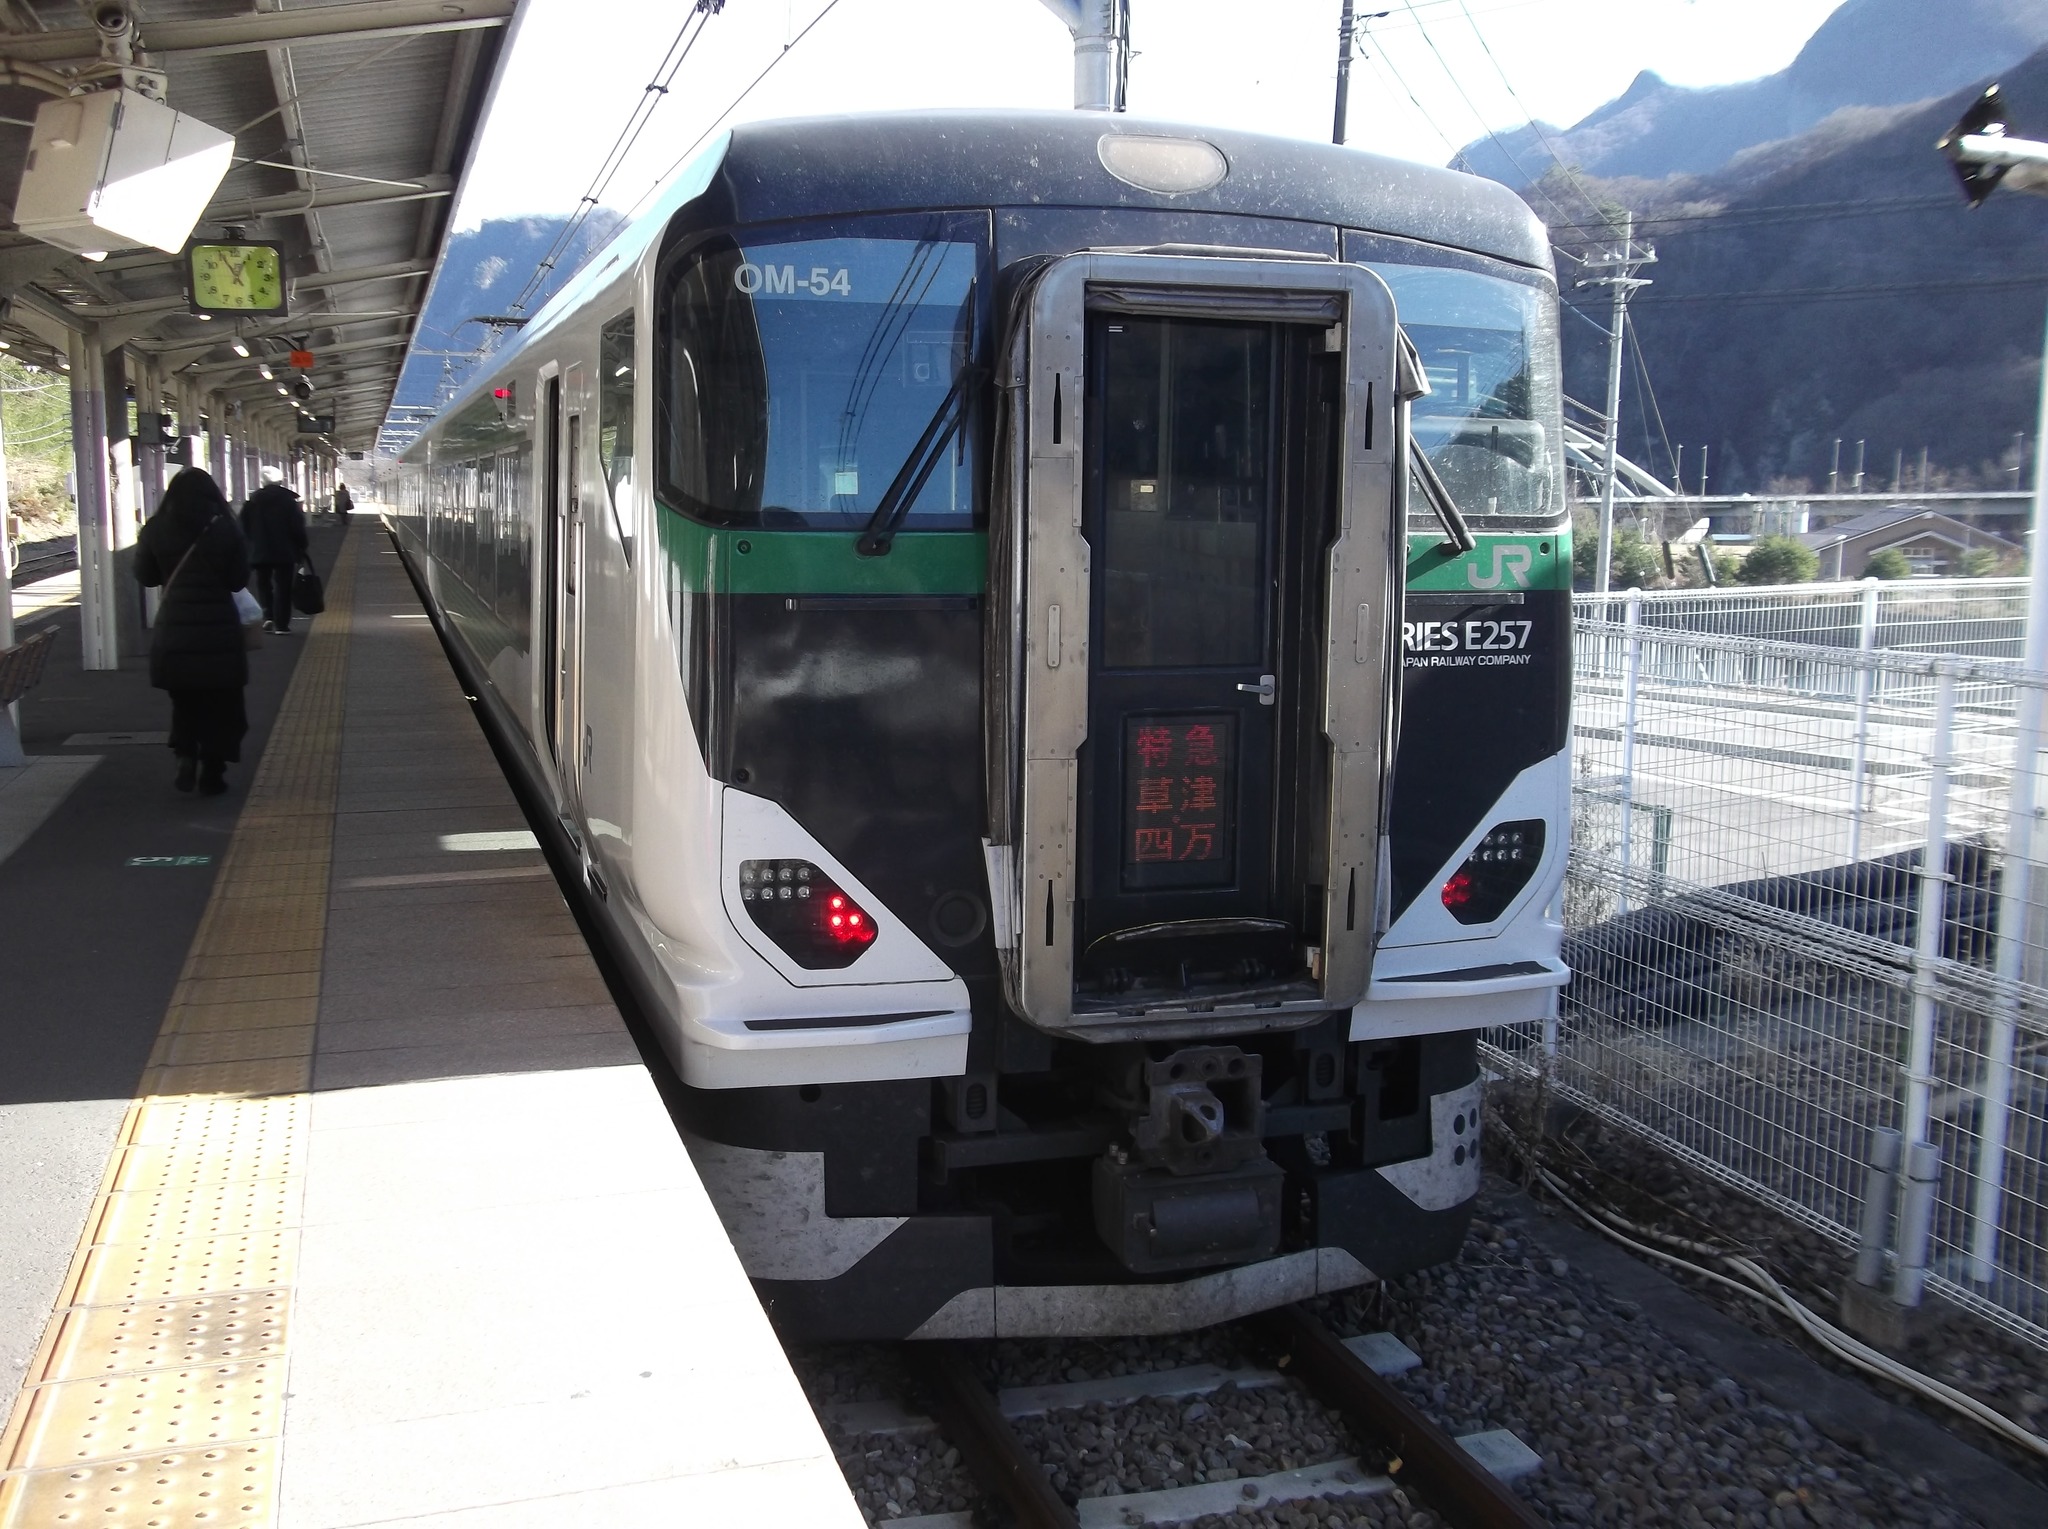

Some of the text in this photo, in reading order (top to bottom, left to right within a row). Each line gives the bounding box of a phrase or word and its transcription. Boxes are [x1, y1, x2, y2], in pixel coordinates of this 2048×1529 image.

[734, 263, 851, 296] OM-54
[1467, 544, 1533, 589] JR
[1465, 620, 1533, 650] E257
[1430, 655, 1477, 667] RAILWAY
[1477, 654, 1532, 666] COMPANY
[1136, 724, 1218, 768] 特急
[1135, 775, 1217, 814] 草津
